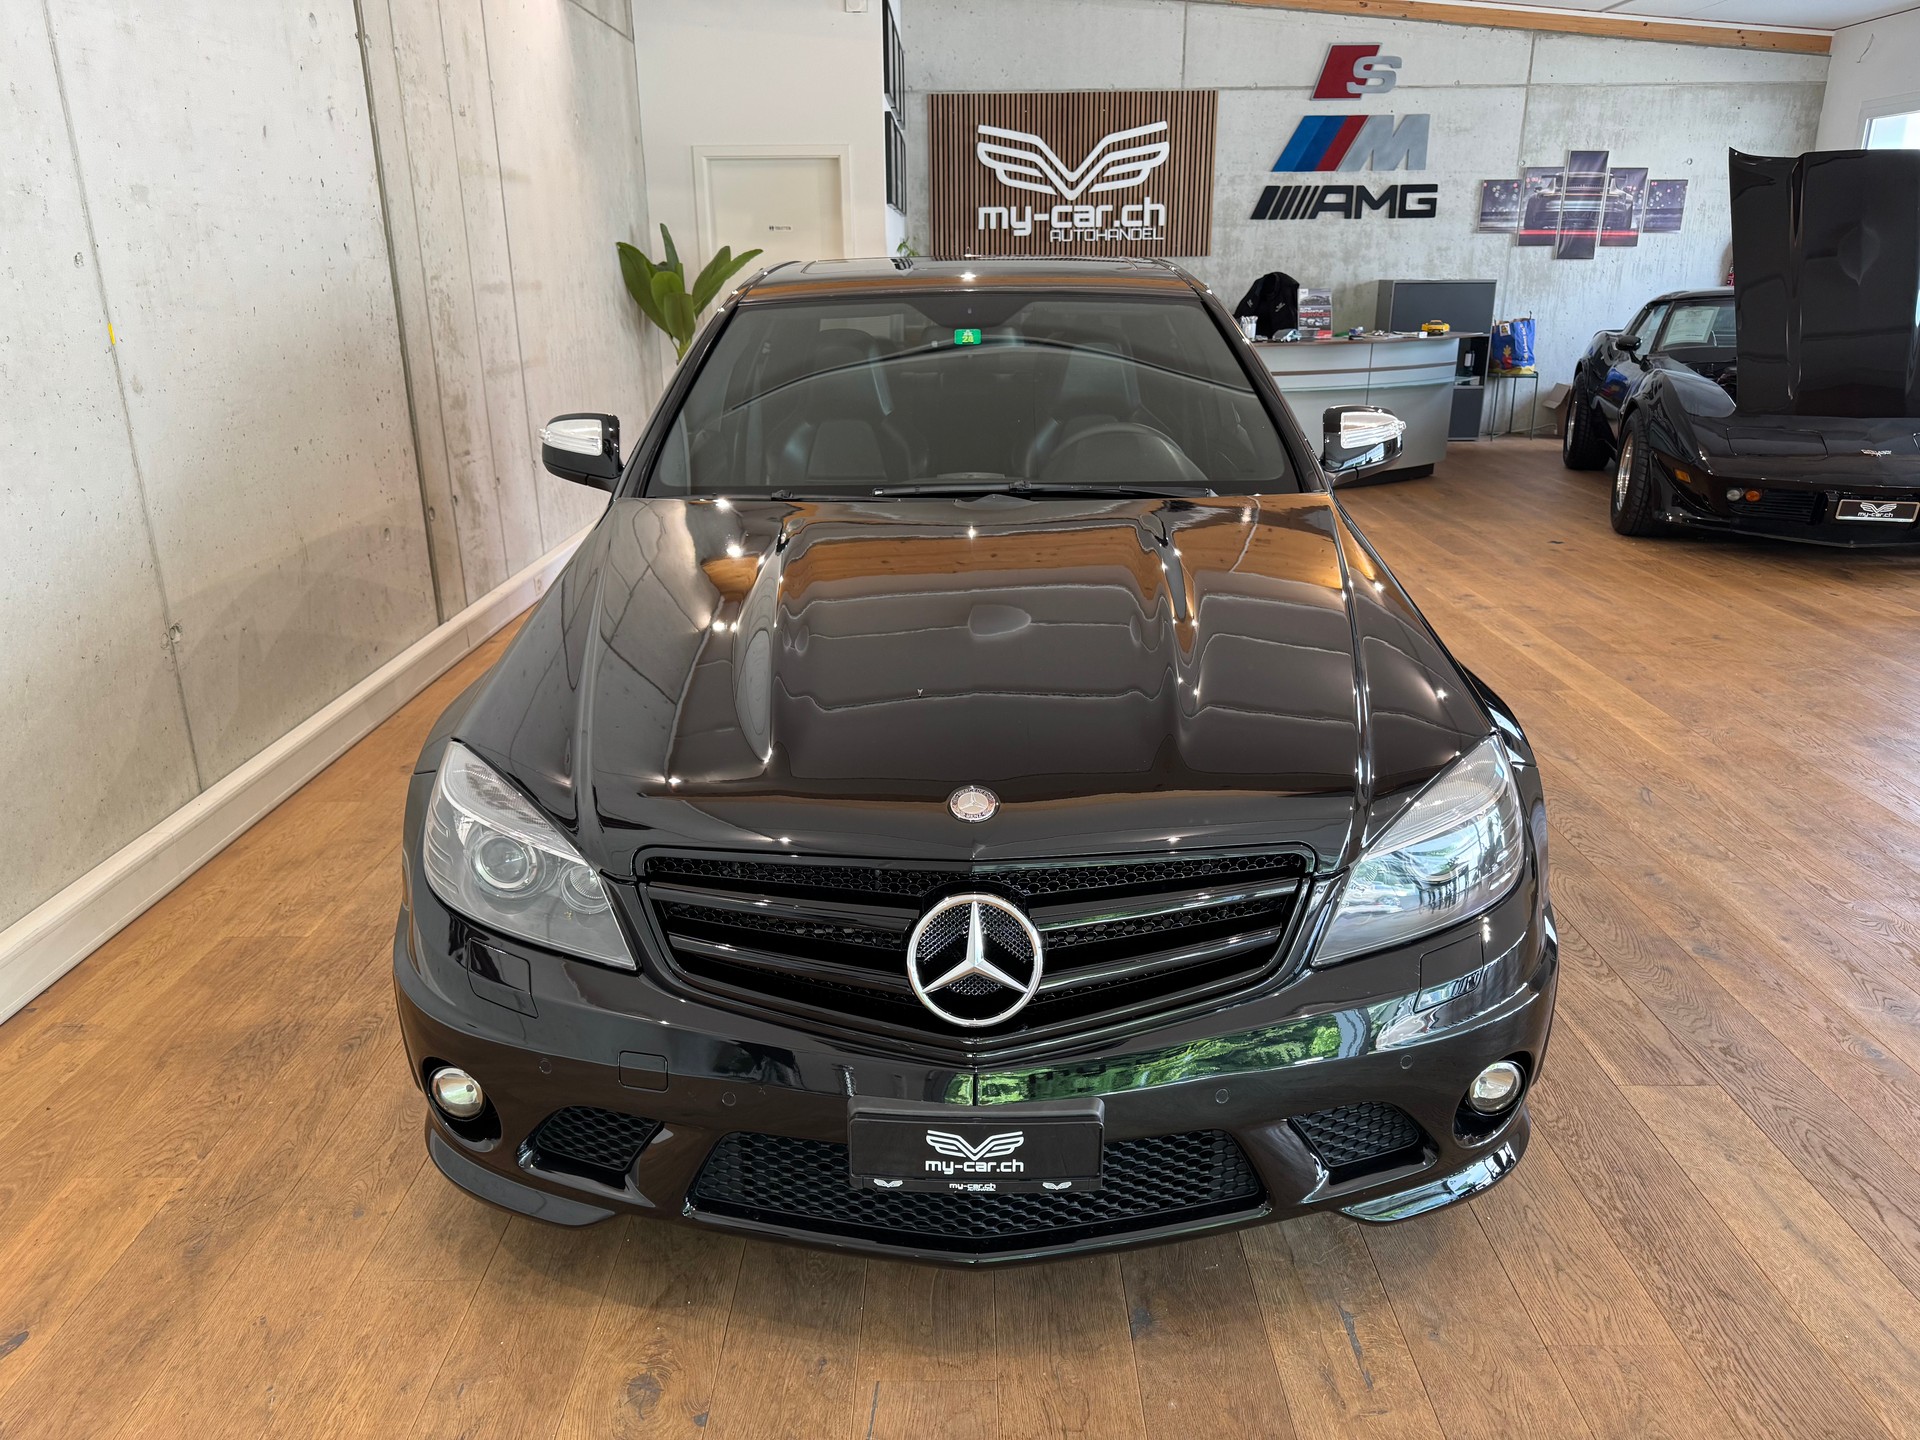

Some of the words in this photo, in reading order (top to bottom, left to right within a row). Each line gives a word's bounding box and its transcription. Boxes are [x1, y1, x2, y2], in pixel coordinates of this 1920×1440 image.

[1346, 55, 1402, 94] S
[1336, 113, 1431, 171] M
[977, 197, 1166, 236] my-car.ch
[1307, 183, 1438, 219] AMG
[1050, 228, 1164, 242] AUTOHANDEL
[925, 1159, 1024, 1174] my-car.ch
